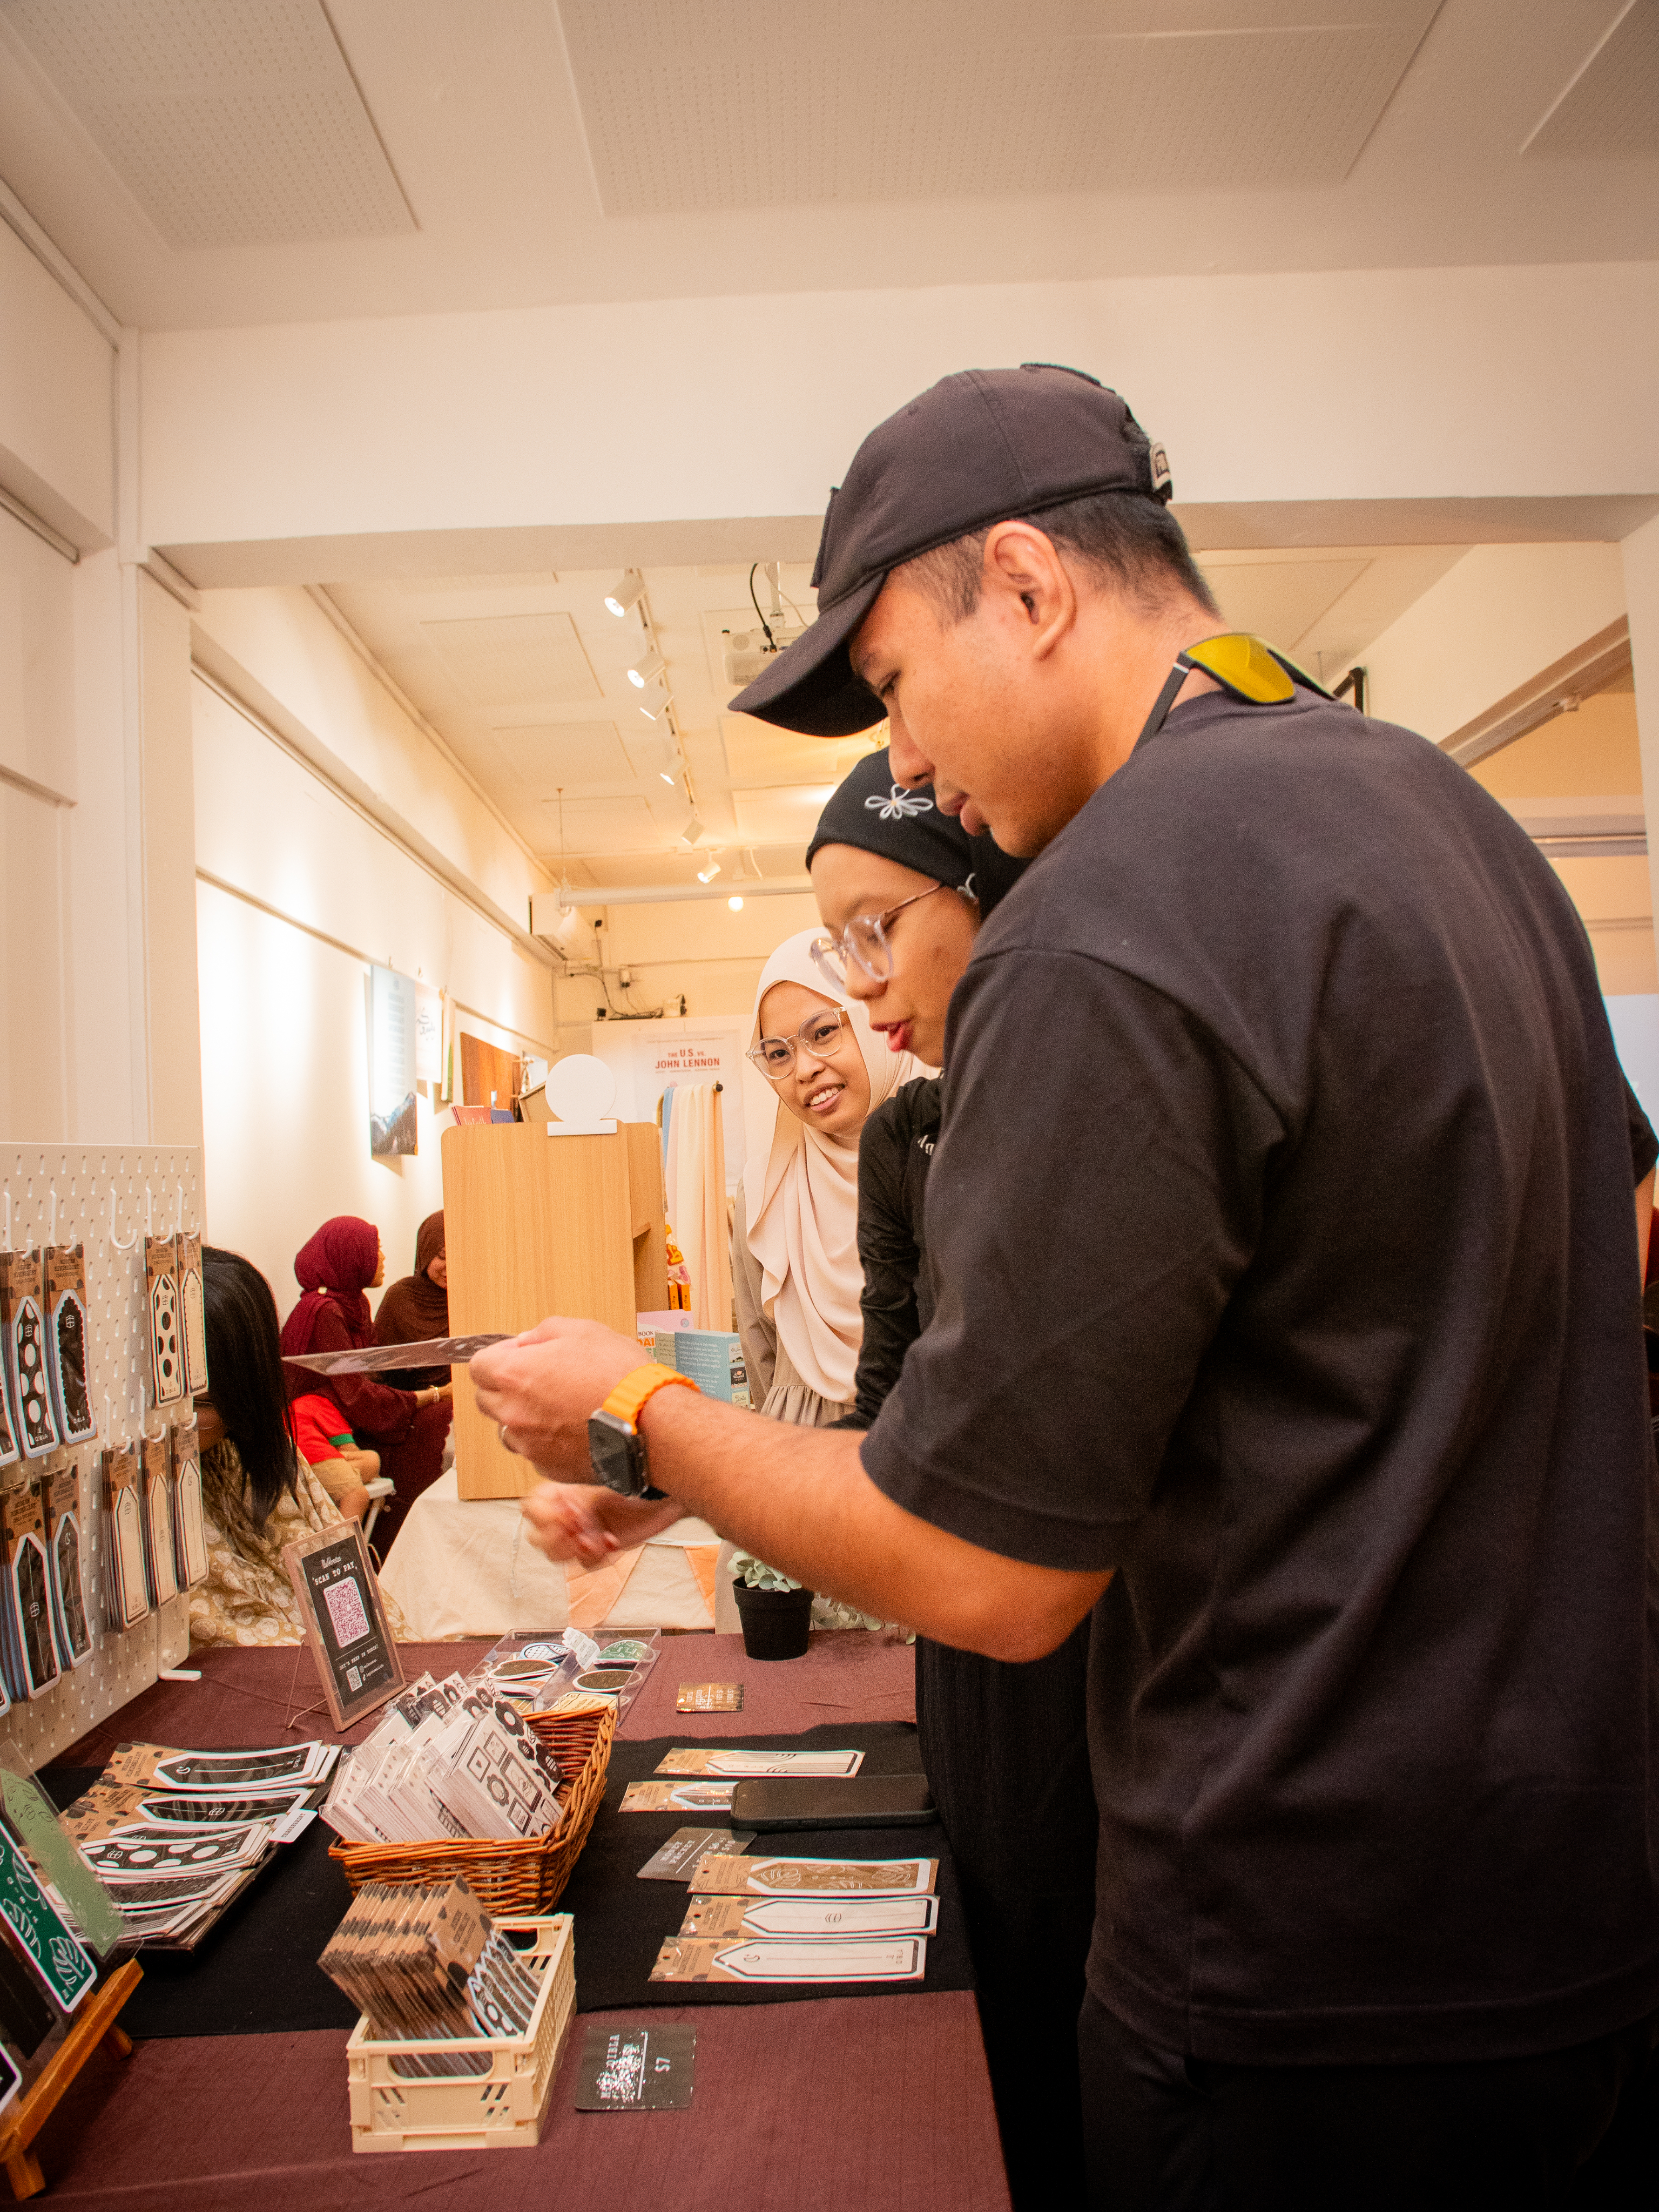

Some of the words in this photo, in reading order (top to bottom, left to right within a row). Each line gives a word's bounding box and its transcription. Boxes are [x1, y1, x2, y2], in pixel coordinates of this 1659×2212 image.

[655, 1060, 679, 1069] JOHN
[683, 1057, 720, 1068] LENNON
[73, 1416, 86, 1425] QIBLA
[35, 1434, 49, 1442] QIBLA
[332, 1568, 341, 1577] TO
[293, 1754, 302, 1768] QIBLA
[281, 1813, 306, 1838] TRANSPARENT
[660, 1841, 683, 1862] MONEY
[669, 1840, 695, 1864] PACKET
[606, 2034, 620, 2068] QIBLA
